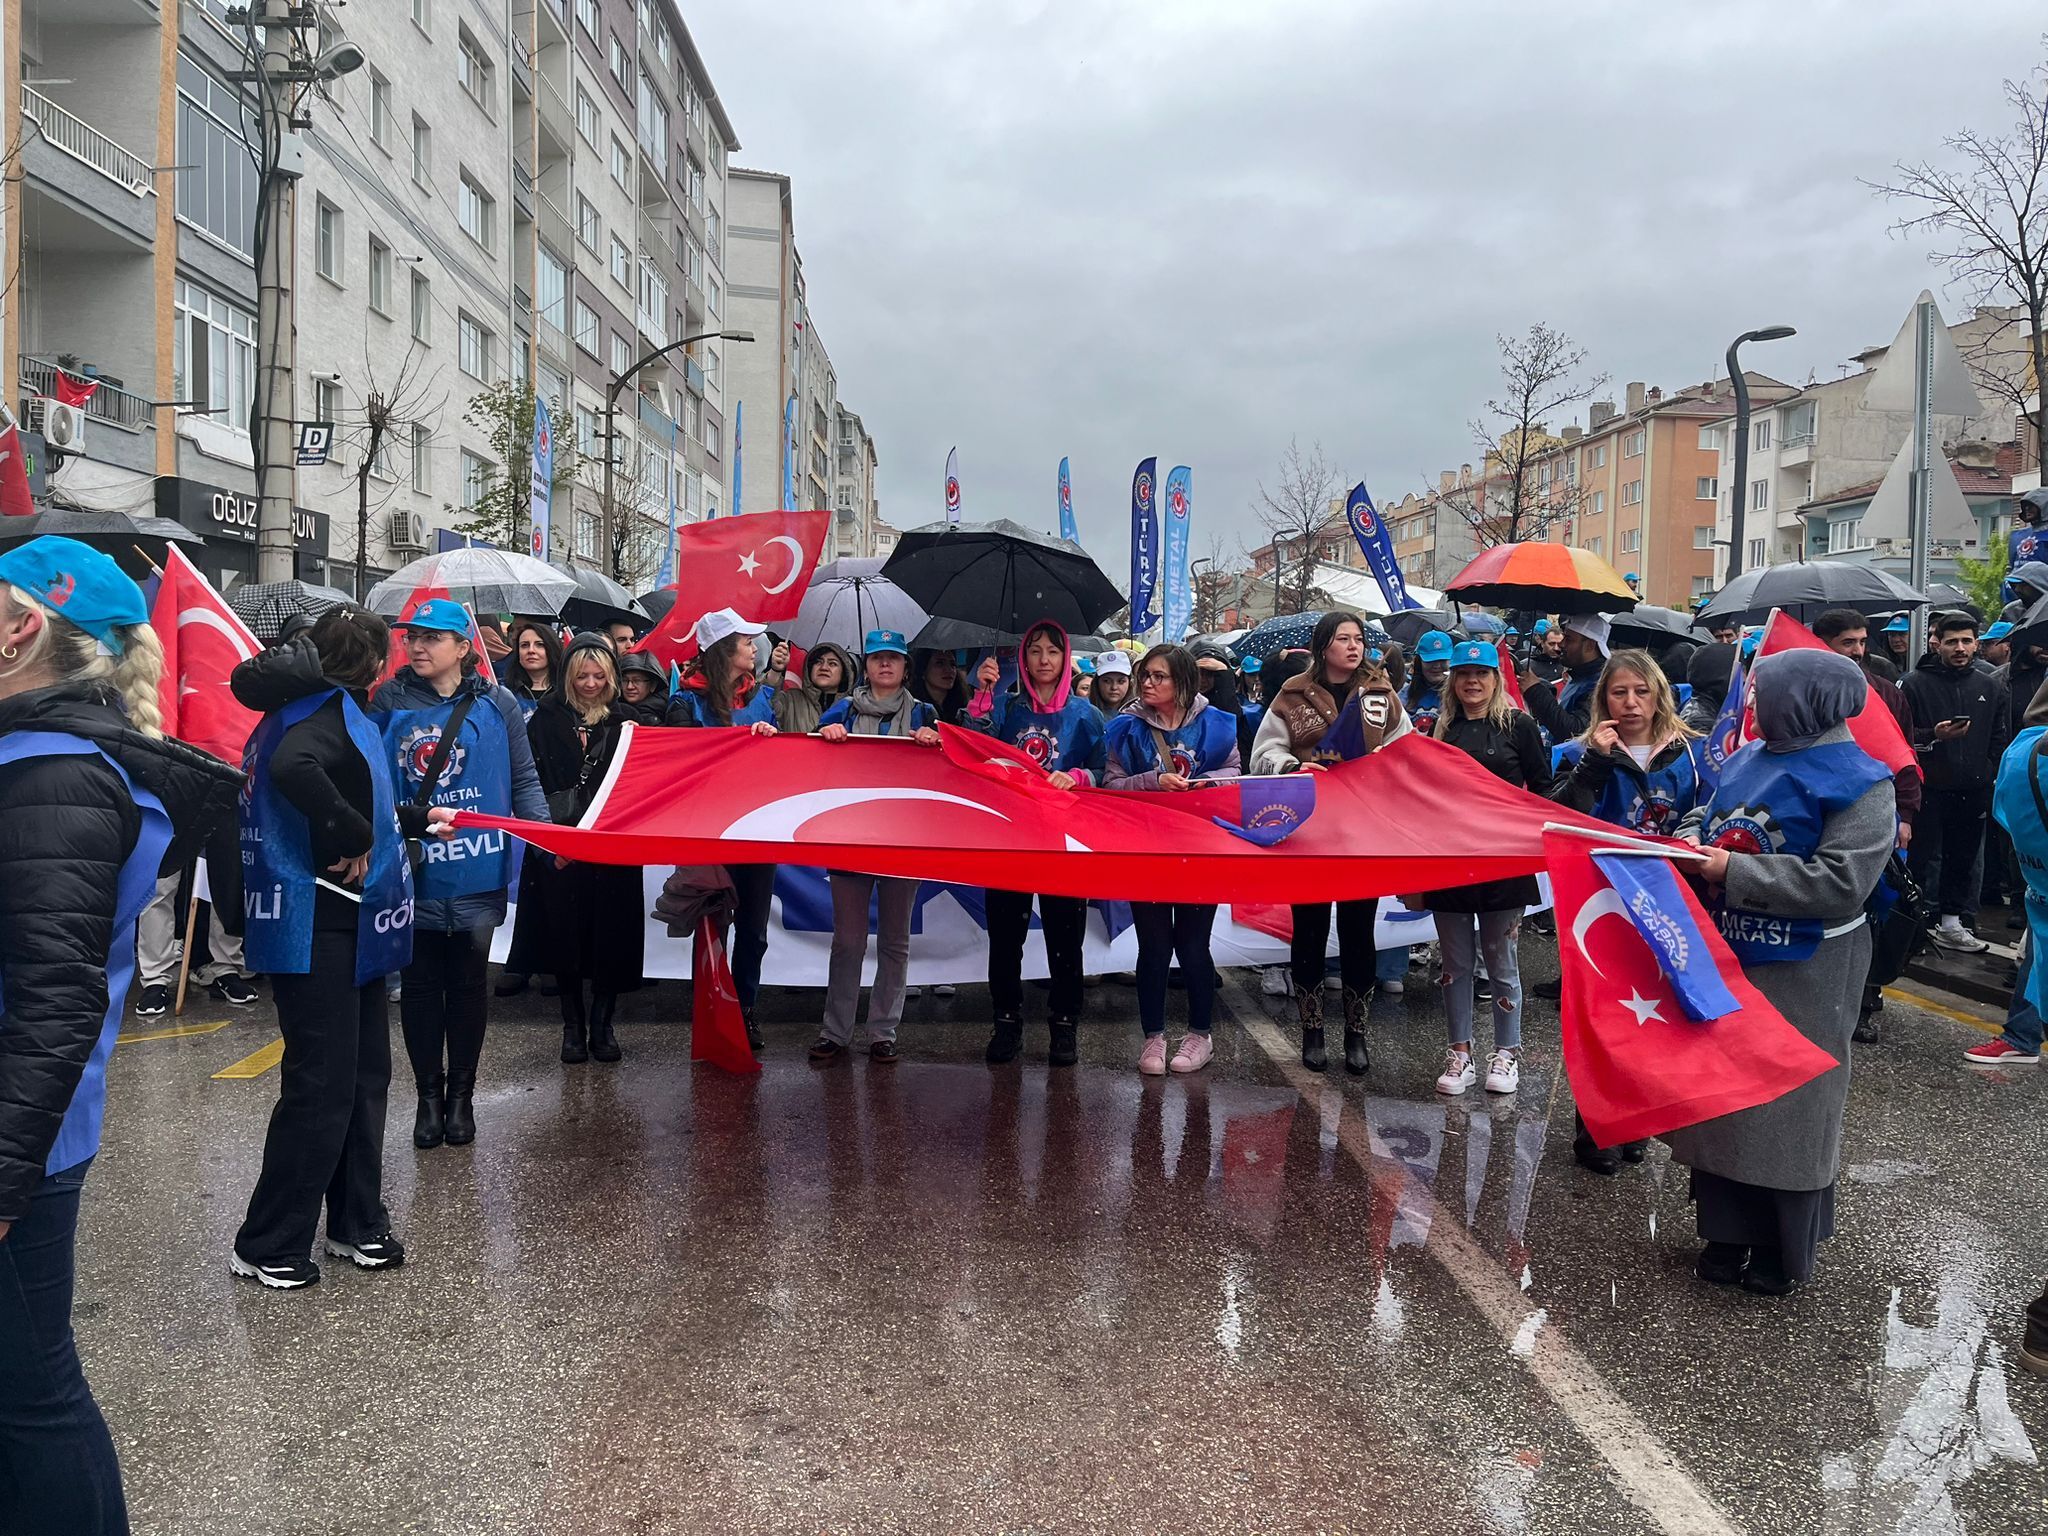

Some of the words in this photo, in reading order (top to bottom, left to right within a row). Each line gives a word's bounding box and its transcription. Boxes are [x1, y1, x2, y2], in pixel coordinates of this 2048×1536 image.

[310, 430, 322, 446] D
[212, 490, 257, 528] OĞUZ
[1169, 527, 1180, 596] METAL
[411, 738, 431, 751] METAL
[436, 786, 482, 805] METAL
[1718, 820, 1746, 835] METAL
